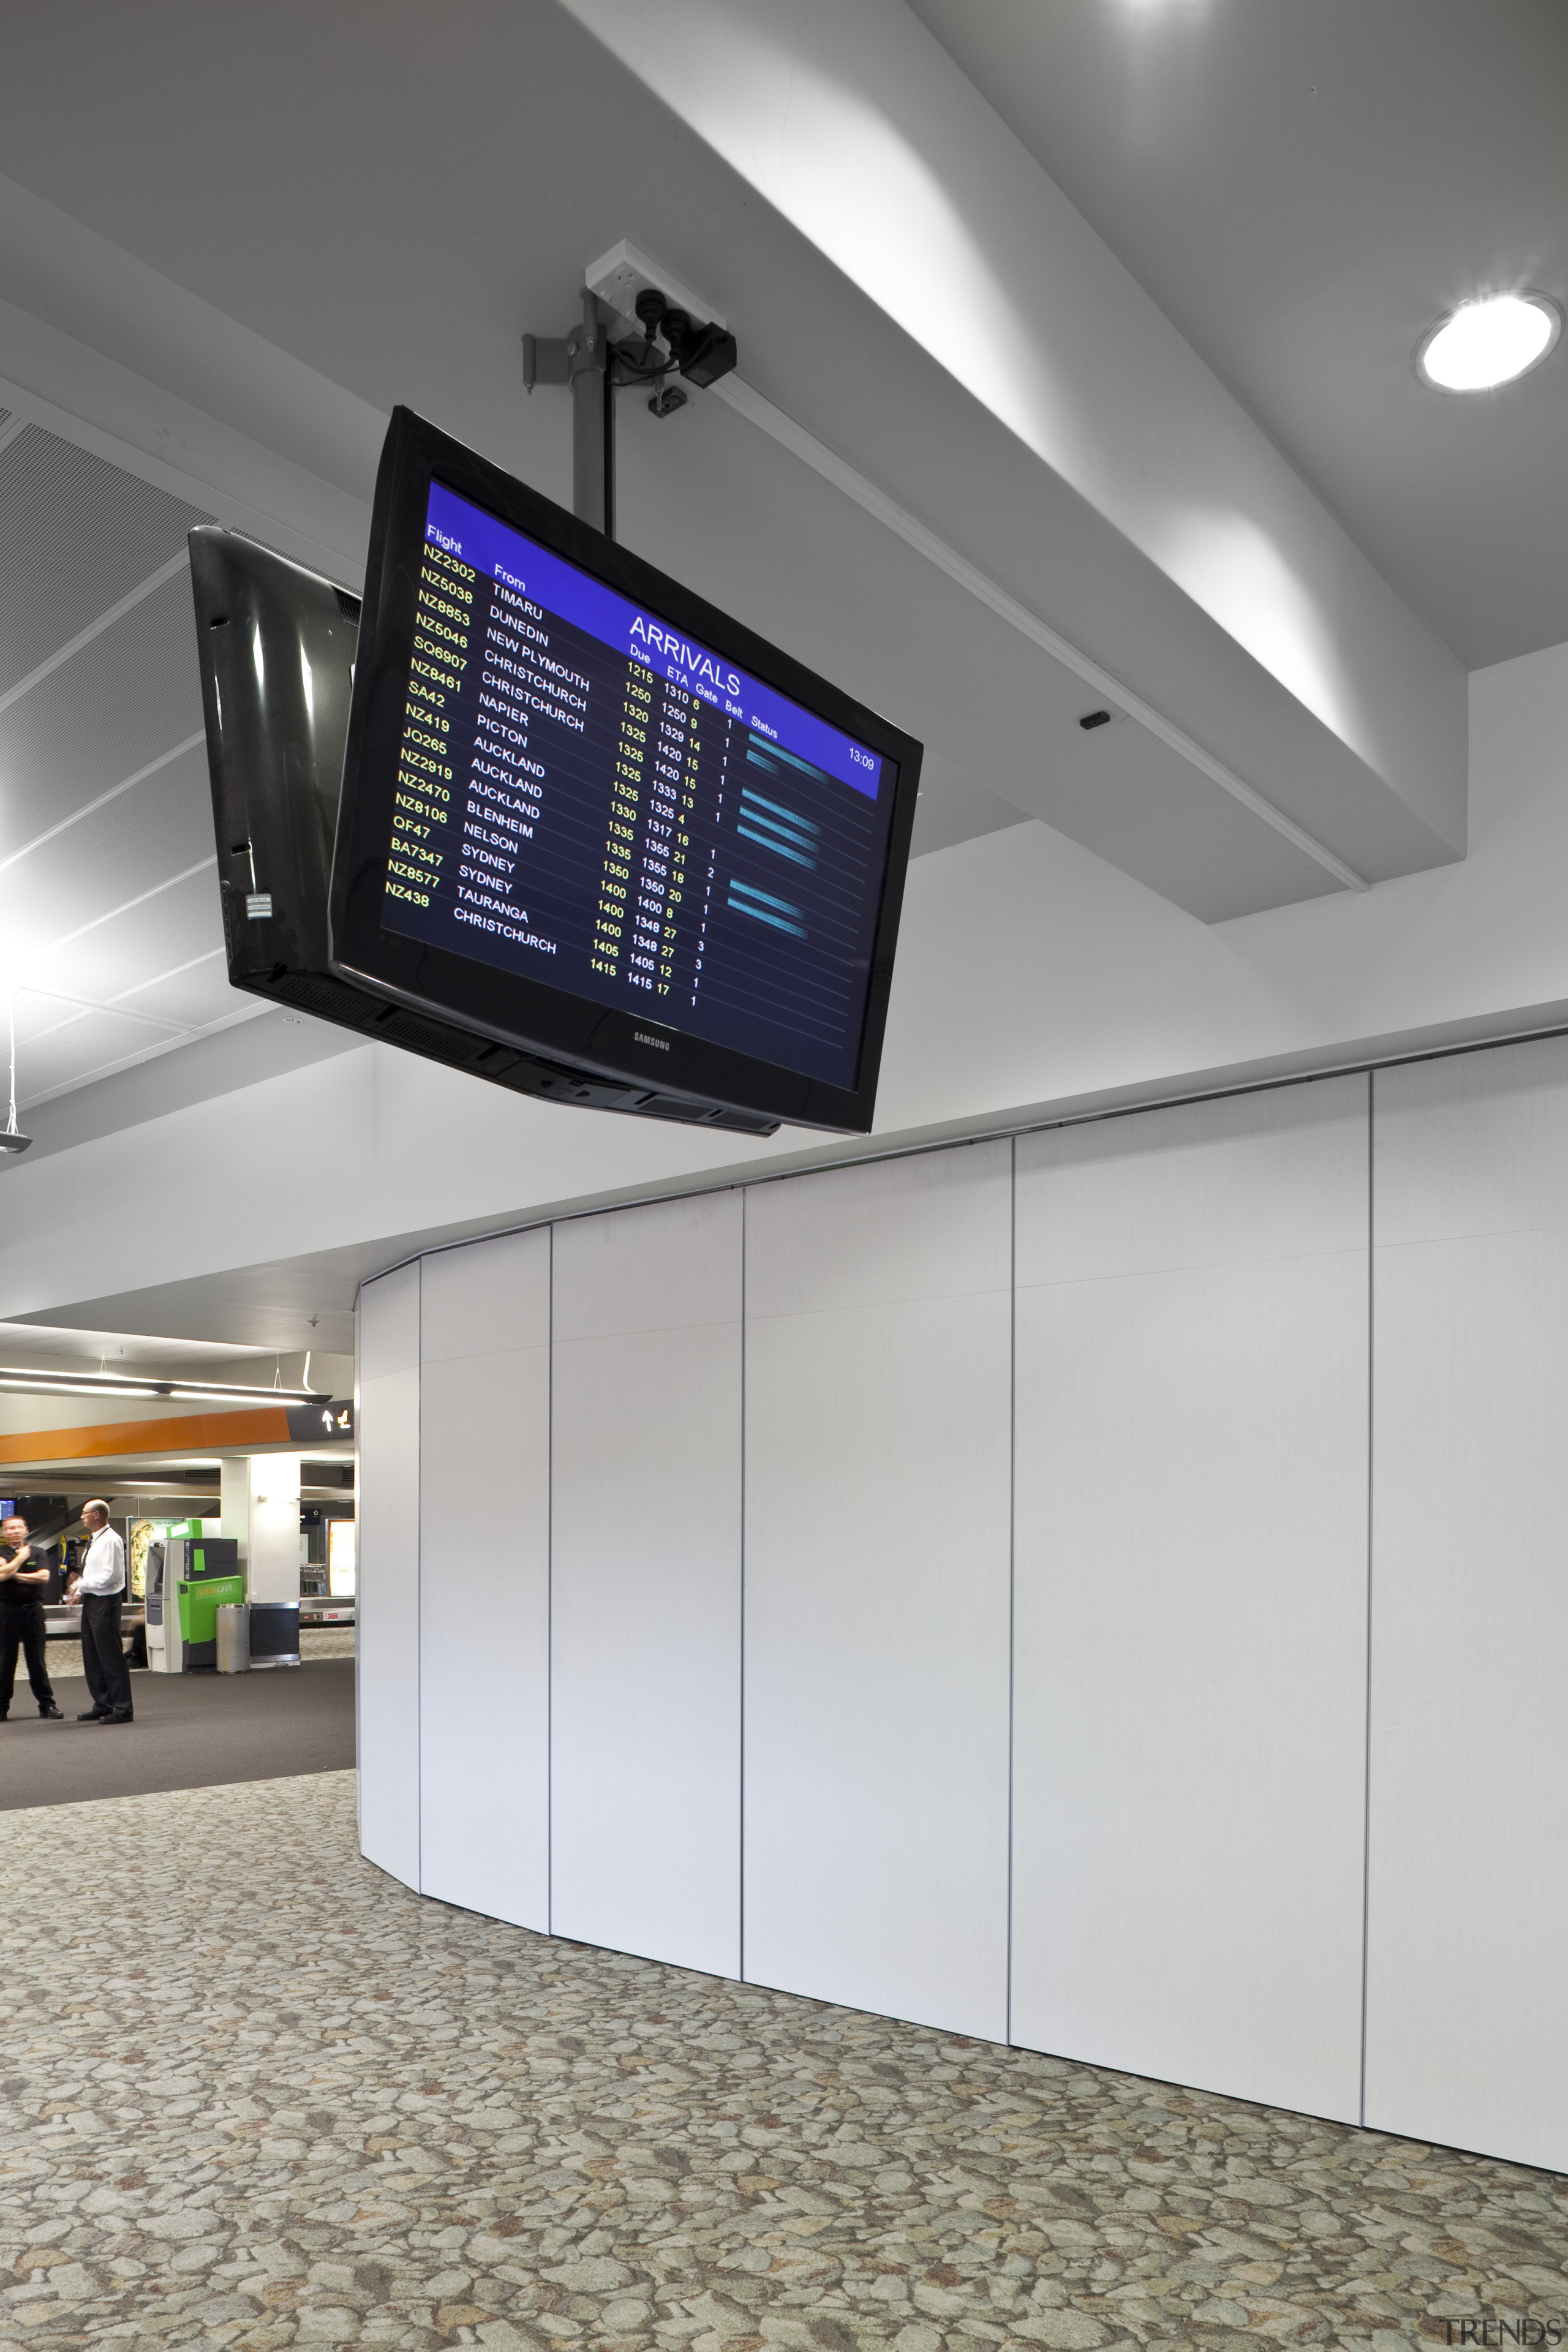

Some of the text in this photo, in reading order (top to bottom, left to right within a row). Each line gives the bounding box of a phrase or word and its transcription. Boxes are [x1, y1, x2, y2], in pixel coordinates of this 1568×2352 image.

[416, 611, 725, 785] NZ5046 CHRISTCHURCH 1325 1420 15 1
[418, 589, 470, 627] NZ8853
[486, 627, 519, 653] NEW
[521, 645, 590, 692] PLYMOUTH
[623, 701, 649, 723] 1320
[660, 722, 684, 742] 1329
[689, 737, 701, 752] 14
[723, 756, 727, 767] 1
[421, 566, 729, 748] NZ5038 DUNEDIN 1250 1250 9 1
[424, 543, 732, 729] NZ2302 TIMARU 1215 1310 6 1
[427, 524, 778, 739] Flight From Due ETA Gate Belt Status
[629, 616, 741, 696] ARRIVALS
[405, 703, 715, 859] NZ419 AUCKLAND 1330 1317 16 1
[409, 680, 685, 825] SA42 PICTON 1325 1325 4
[411, 657, 720, 823] NZ8461 NAPIER 1325 1333 13 1
[413, 636, 723, 804] SQ6907 CHRISTCHURCH 1325 1420 15 1
[850, 747, 875, 771] 13:09
[396, 792, 706, 933] NZ8106 NELSON 1400 1400 8 1
[398, 769, 708, 914] NZ2470 BLENHEIM 1350 1350 20 1
[401, 747, 710, 896] NZ2919 AUCKLAND 1335 1355 18 1
[403, 726, 714, 878] JQ265 AUCKLAND 1335 1355 21 2
[385, 881, 696, 1006] NZ438 CHRISTCHURCH 1415 1415 17 1
[388, 859, 698, 988] NZ8577 TAURANGA 1405 1405 12 1
[391, 837, 702, 970] BA7347 SYDNEY 1400 1348 27 3
[393, 815, 704, 952] QF47 SYDNEY 1400 1348 27 3
[634, 1031, 670, 1051] SAMSUNG
[198, 1583, 233, 1597] quickcash
